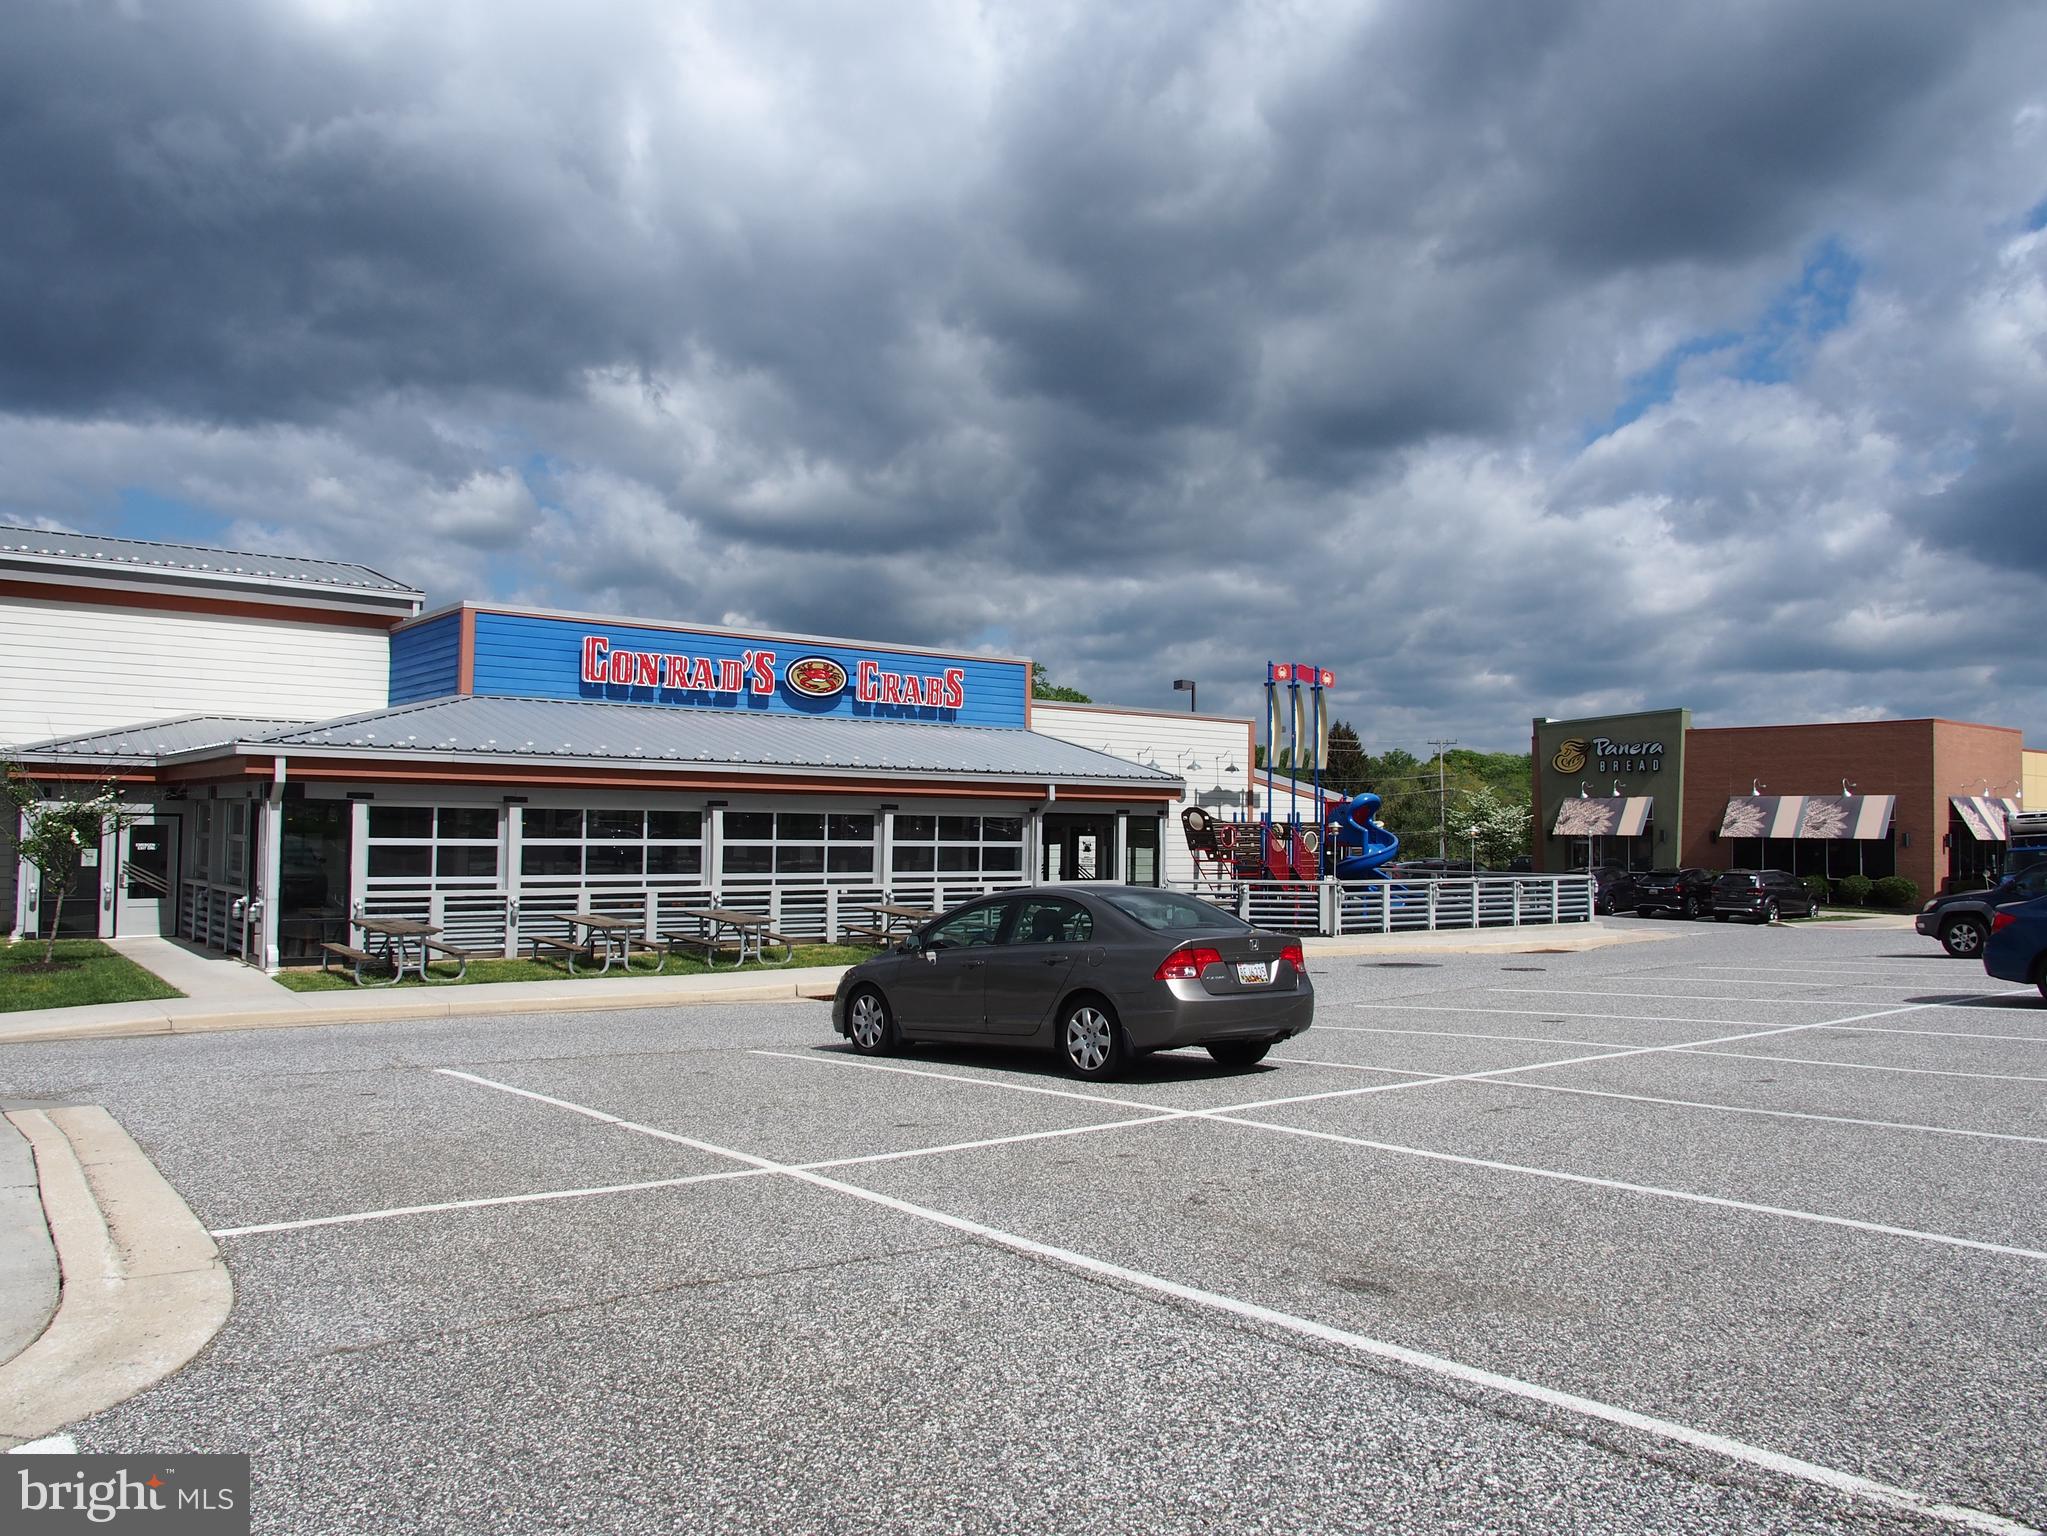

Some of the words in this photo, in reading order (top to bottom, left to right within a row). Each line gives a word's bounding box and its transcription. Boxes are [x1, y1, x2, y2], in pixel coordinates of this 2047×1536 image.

[581, 636, 775, 696] CONRAD'S
[856, 660, 964, 709] CRABS
[1593, 737, 1664, 756] Panera
[1599, 759, 1660, 773] BREAD
